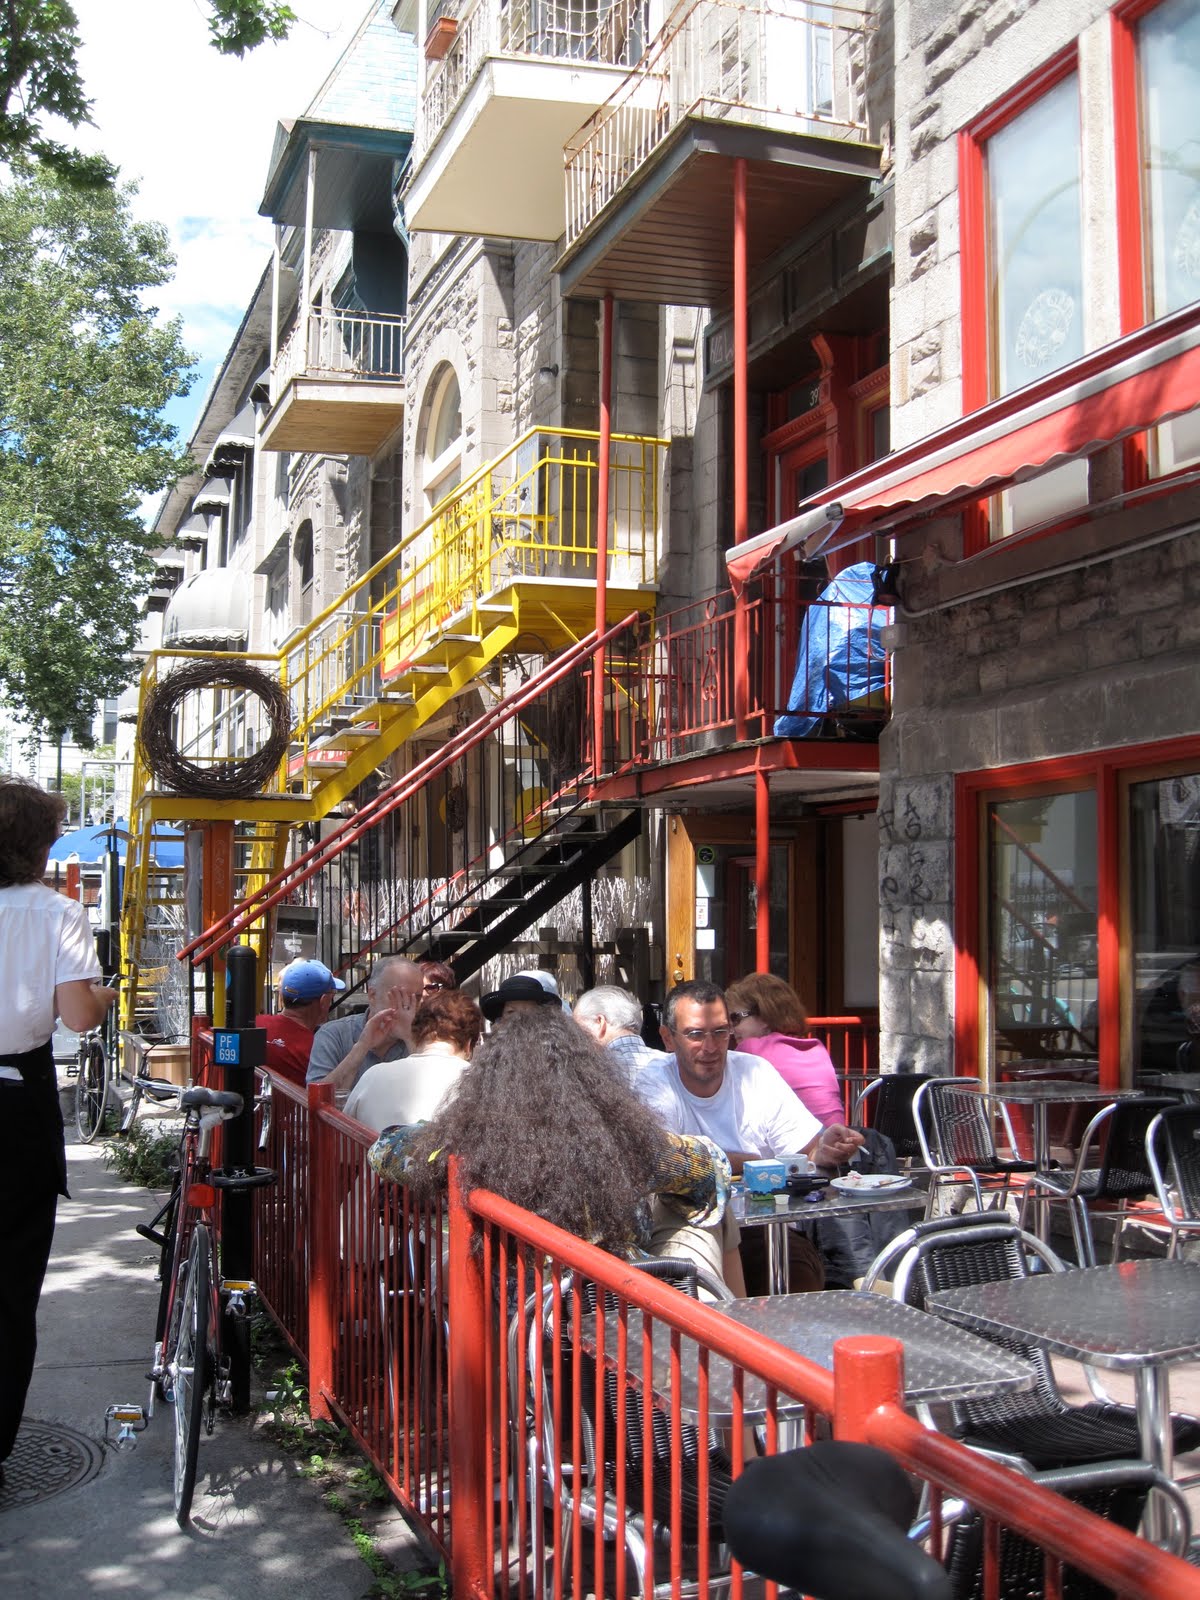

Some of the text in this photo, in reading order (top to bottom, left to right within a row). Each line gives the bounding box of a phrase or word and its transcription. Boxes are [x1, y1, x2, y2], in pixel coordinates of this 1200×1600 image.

[809, 387, 820, 407] 39
[219, 1035, 233, 1048] PF
[219, 1048, 236, 1061] 699
